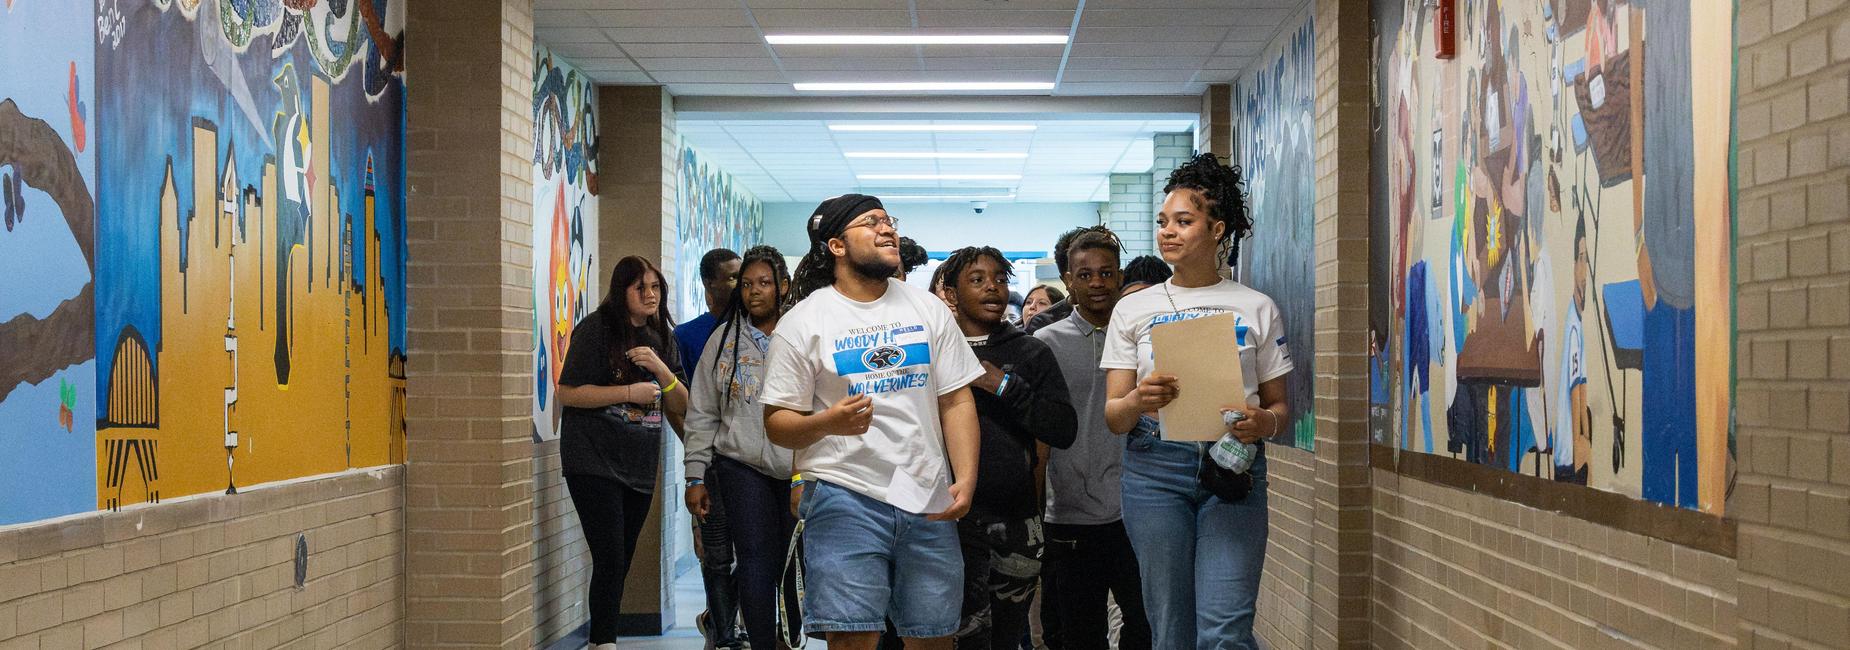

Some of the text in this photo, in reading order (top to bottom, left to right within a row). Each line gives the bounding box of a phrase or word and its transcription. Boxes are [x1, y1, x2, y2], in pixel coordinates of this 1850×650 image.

[848, 321, 902, 335] WELCOME TO
[834, 332, 879, 351] WOODY
[865, 372, 885, 380] HOME
[894, 367, 911, 376] THE
[1571, 351, 1579, 377] 15
[847, 373, 929, 397] WOLVERINES!
